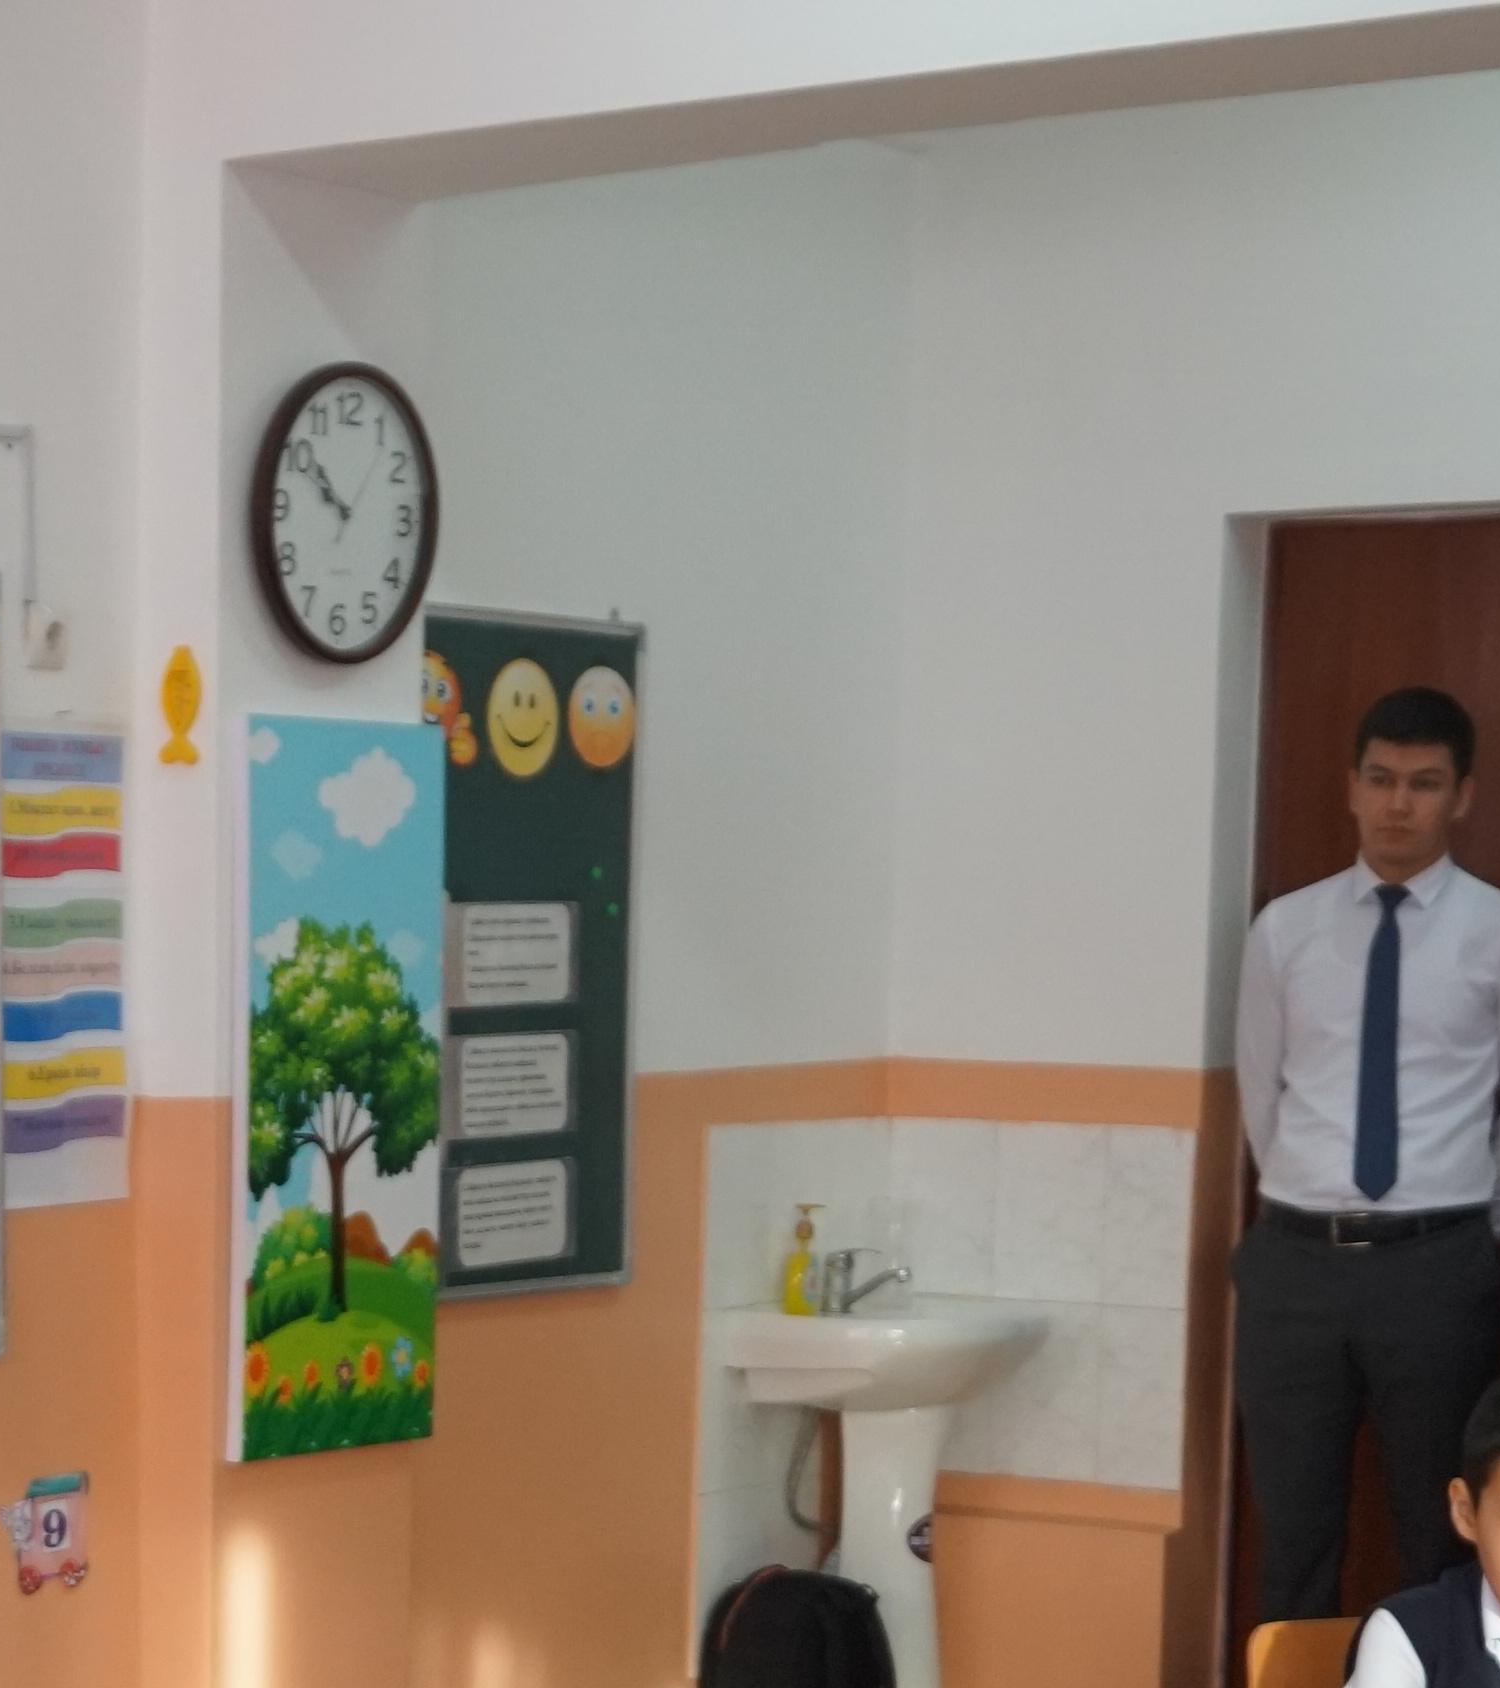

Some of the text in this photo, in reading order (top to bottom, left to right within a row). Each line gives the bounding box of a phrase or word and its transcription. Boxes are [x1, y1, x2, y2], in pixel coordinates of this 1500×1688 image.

[307, 402, 329, 437] 11
[335, 391, 364, 427] 12
[373, 416, 385, 447] 1
[284, 437, 315, 474] 10
[390, 450, 407, 485] 2
[273, 487, 290, 522] 9
[396, 503, 413, 538] 3
[278, 540, 297, 577] 8
[382, 557, 401, 590] 4
[300, 584, 318, 618] 7
[360, 590, 378, 625] 5
[328, 603, 348, 637] 6
[43, 1508, 68, 1549] 9
